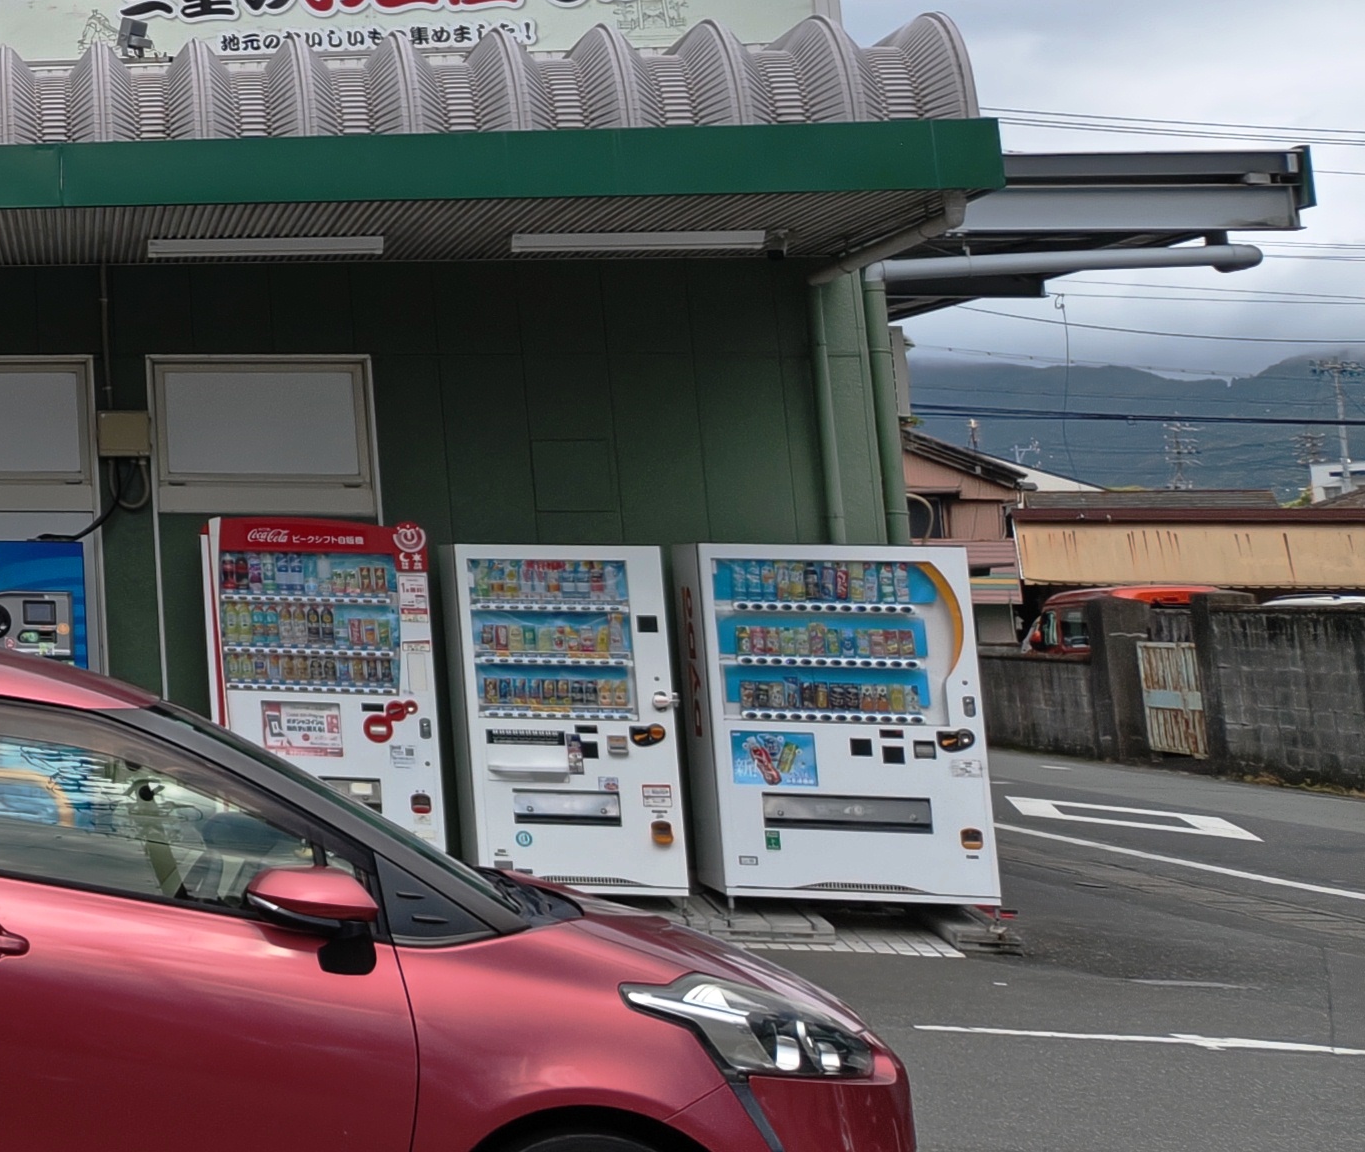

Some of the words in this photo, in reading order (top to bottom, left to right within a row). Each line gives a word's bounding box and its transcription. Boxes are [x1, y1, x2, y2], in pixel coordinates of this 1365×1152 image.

[221, 22, 532, 52] 地元のいしいも集めまし!
